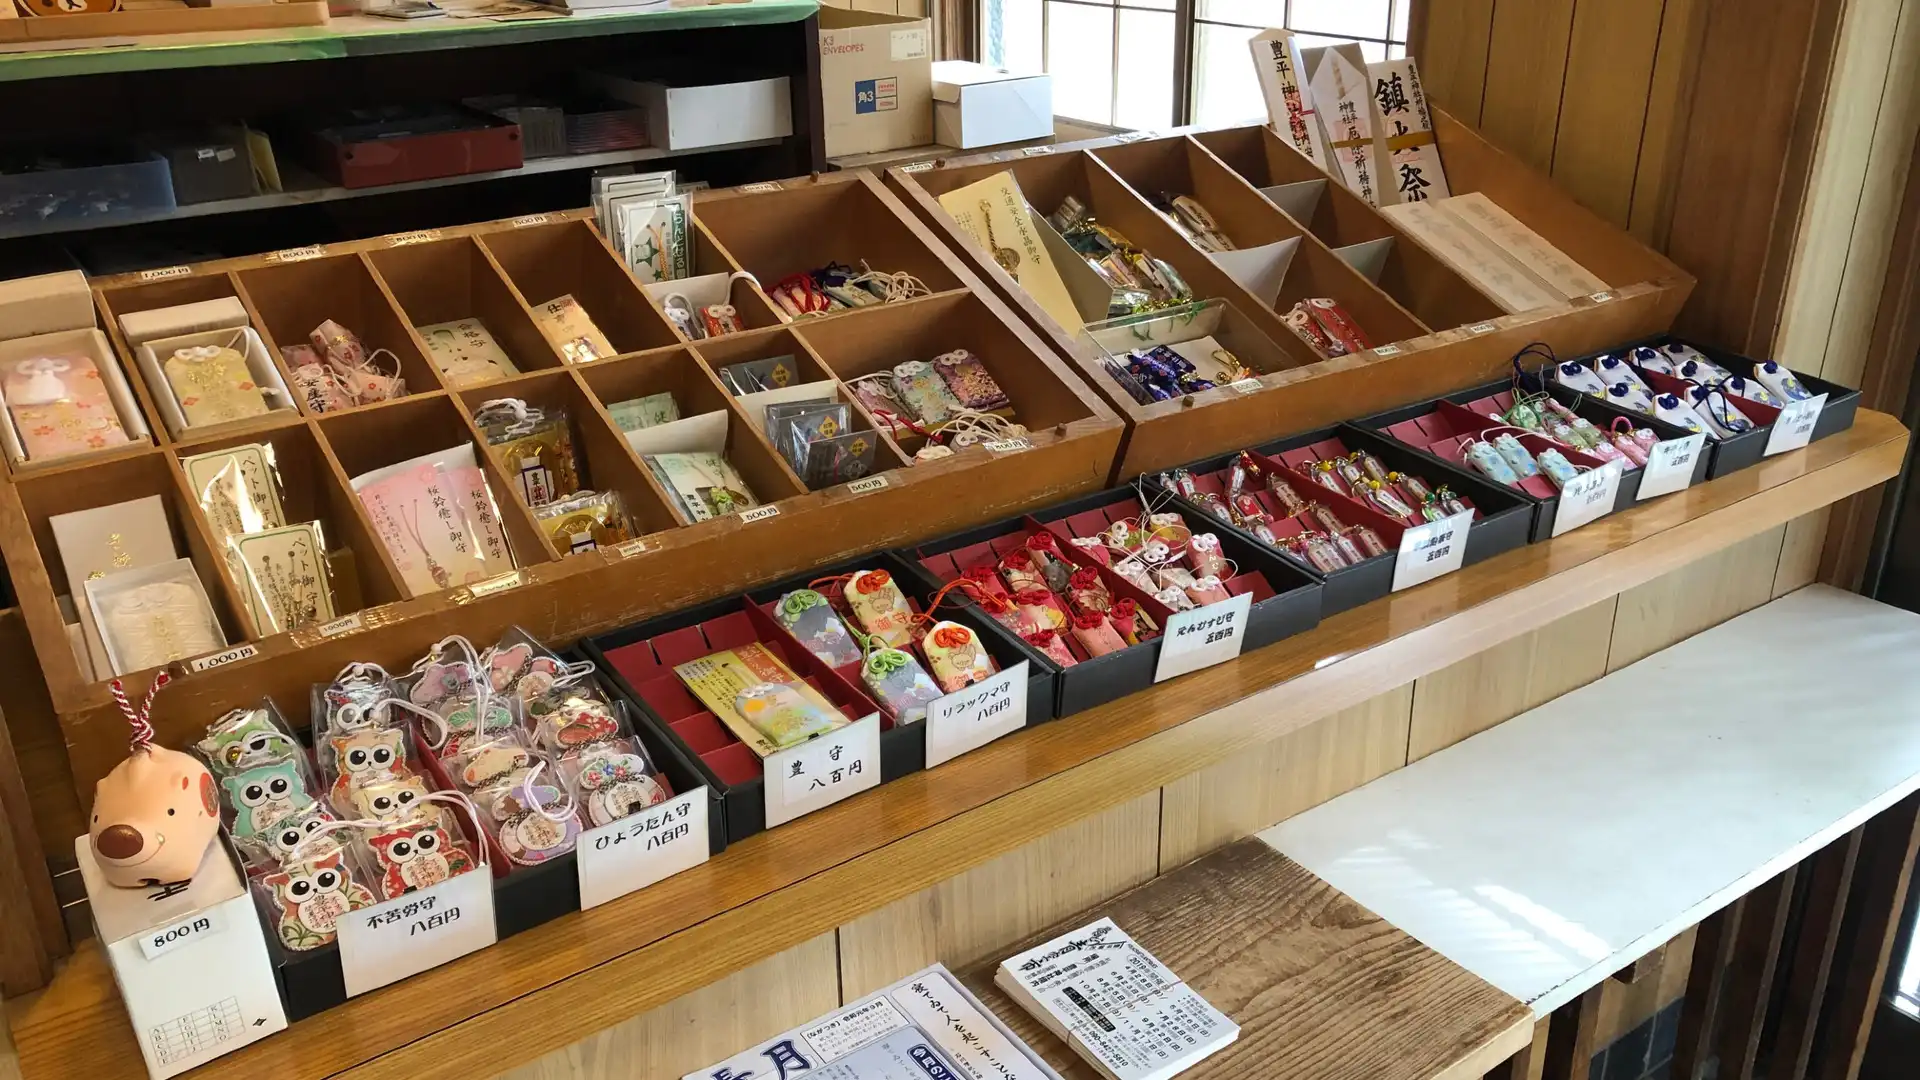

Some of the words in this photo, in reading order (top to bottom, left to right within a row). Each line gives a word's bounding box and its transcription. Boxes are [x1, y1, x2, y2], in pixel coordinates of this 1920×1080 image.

[823, 44, 865, 55] ENVELOPES
[858, 91, 873, 103] 角3
[851, 479, 882, 493] 500円
[427, 484, 468, 554] 桜鈴癒し御守
[470, 489, 504, 560] 桜鈴癒し御守
[746, 506, 778, 521] 500円
[292, 536, 319, 605] ペット御守
[1204, 627, 1234, 645] 五百円
[198, 648, 254, 671] 1,000円
[942, 680, 1011, 719] リラックマ守
[977, 697, 1011, 722] 八百円
[808, 759, 863, 791] 八百円
[594, 803, 692, 851] ひょうたん守
[646, 823, 689, 852] 八百円
[365, 896, 437, 929] 不苦労守
[409, 907, 461, 937] 八百円
[154, 917, 210, 948] 800円
